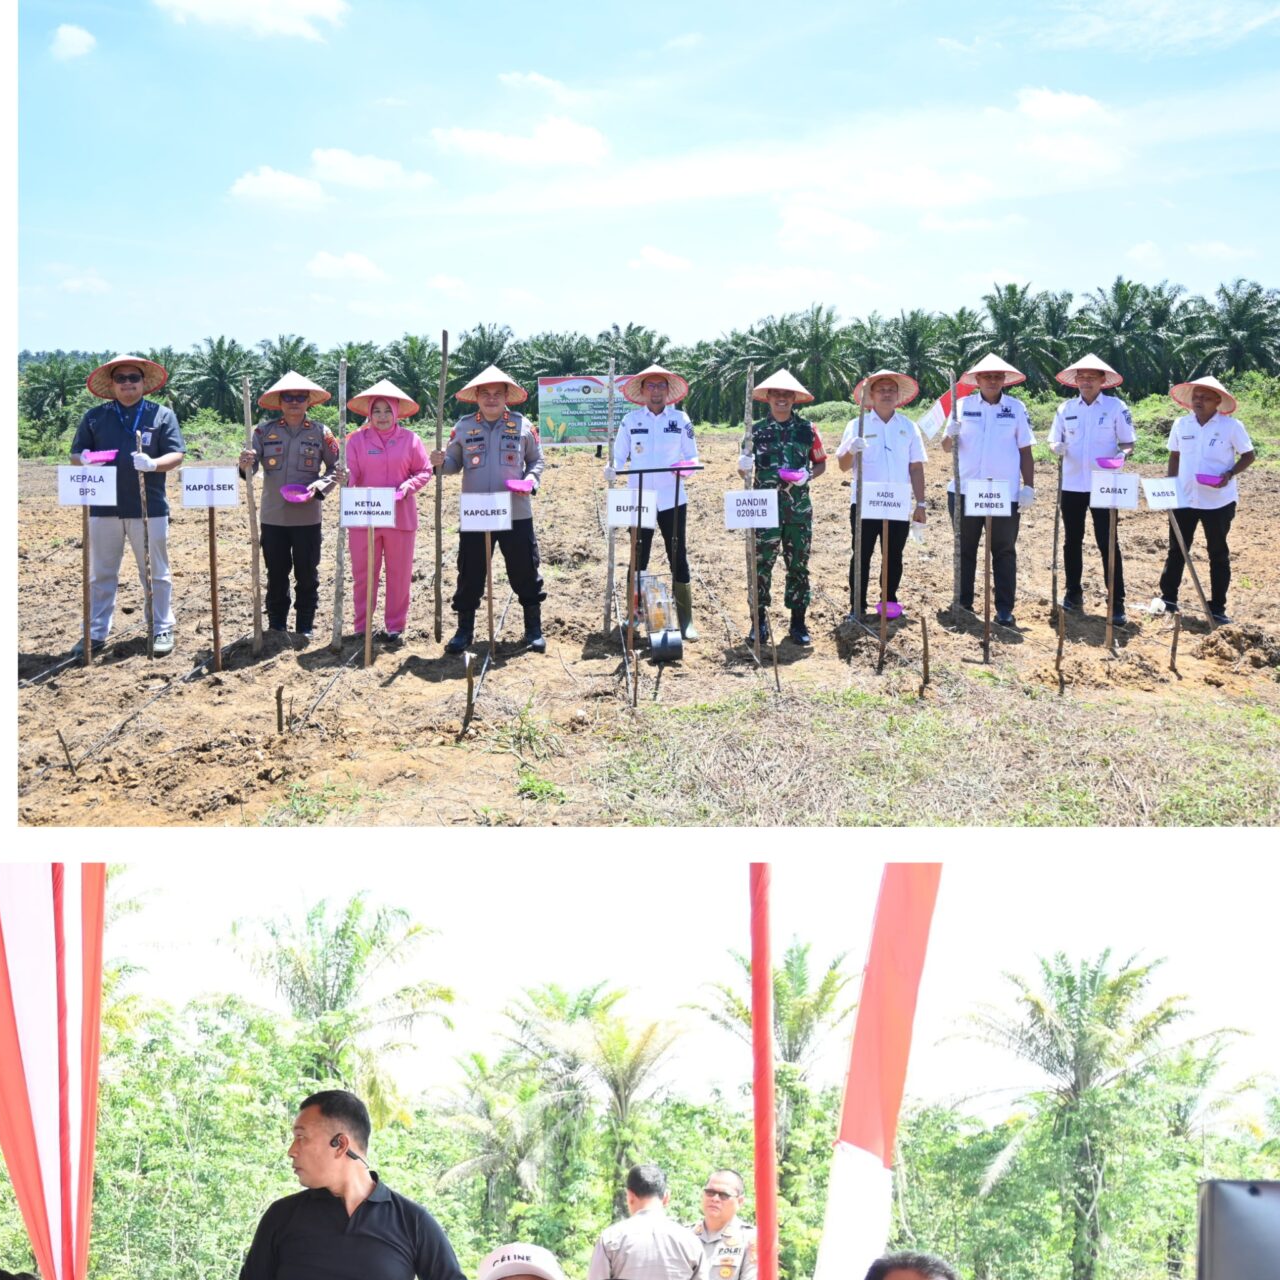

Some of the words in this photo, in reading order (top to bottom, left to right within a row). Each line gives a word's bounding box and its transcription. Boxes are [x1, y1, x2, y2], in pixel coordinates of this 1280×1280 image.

[70, 474, 105, 483] KEPALA
[79, 487, 96, 496] BPS
[876, 491, 895, 499] KADIS
[736, 498, 768, 507] DANDIM
[869, 500, 901, 508] PERTANIAN
[463, 509, 508, 517] KAPOLRES
[736, 509, 768, 518] 0209/LB
